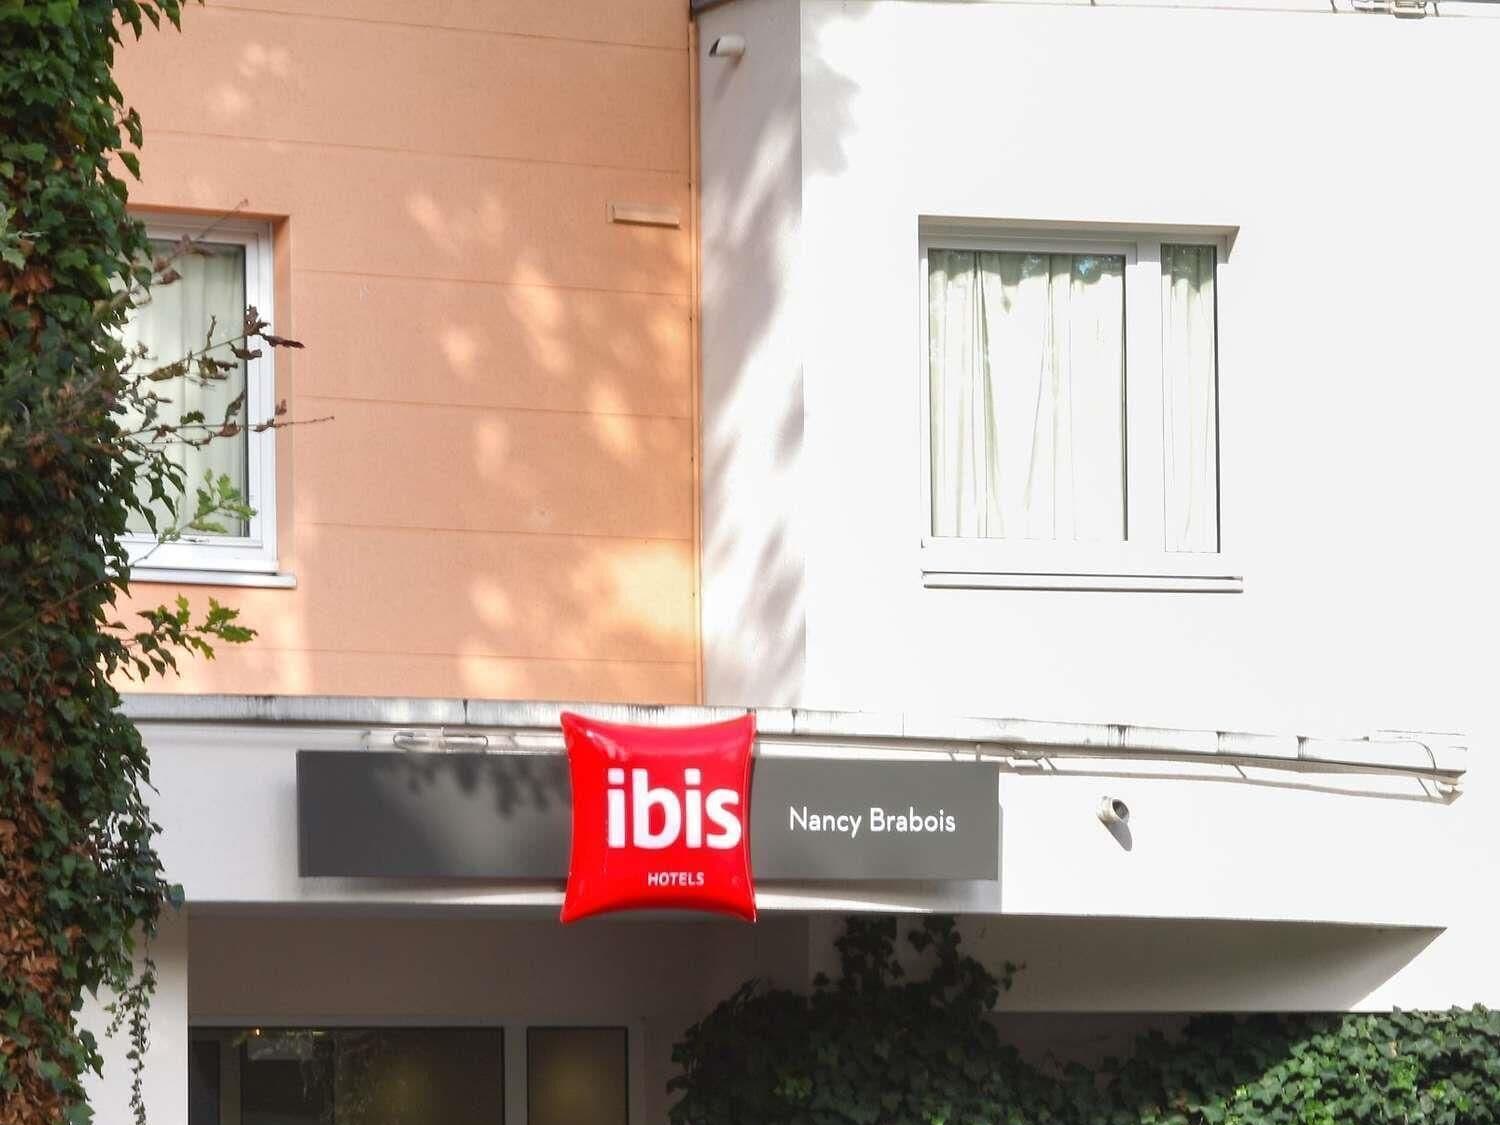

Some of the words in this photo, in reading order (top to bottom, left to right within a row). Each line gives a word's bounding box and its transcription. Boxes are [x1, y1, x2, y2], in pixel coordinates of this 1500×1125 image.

[607, 767, 742, 850] ibis
[789, 805, 862, 839] Nancy
[869, 805, 956, 832] Brabois
[647, 871, 705, 887] HOTELS
